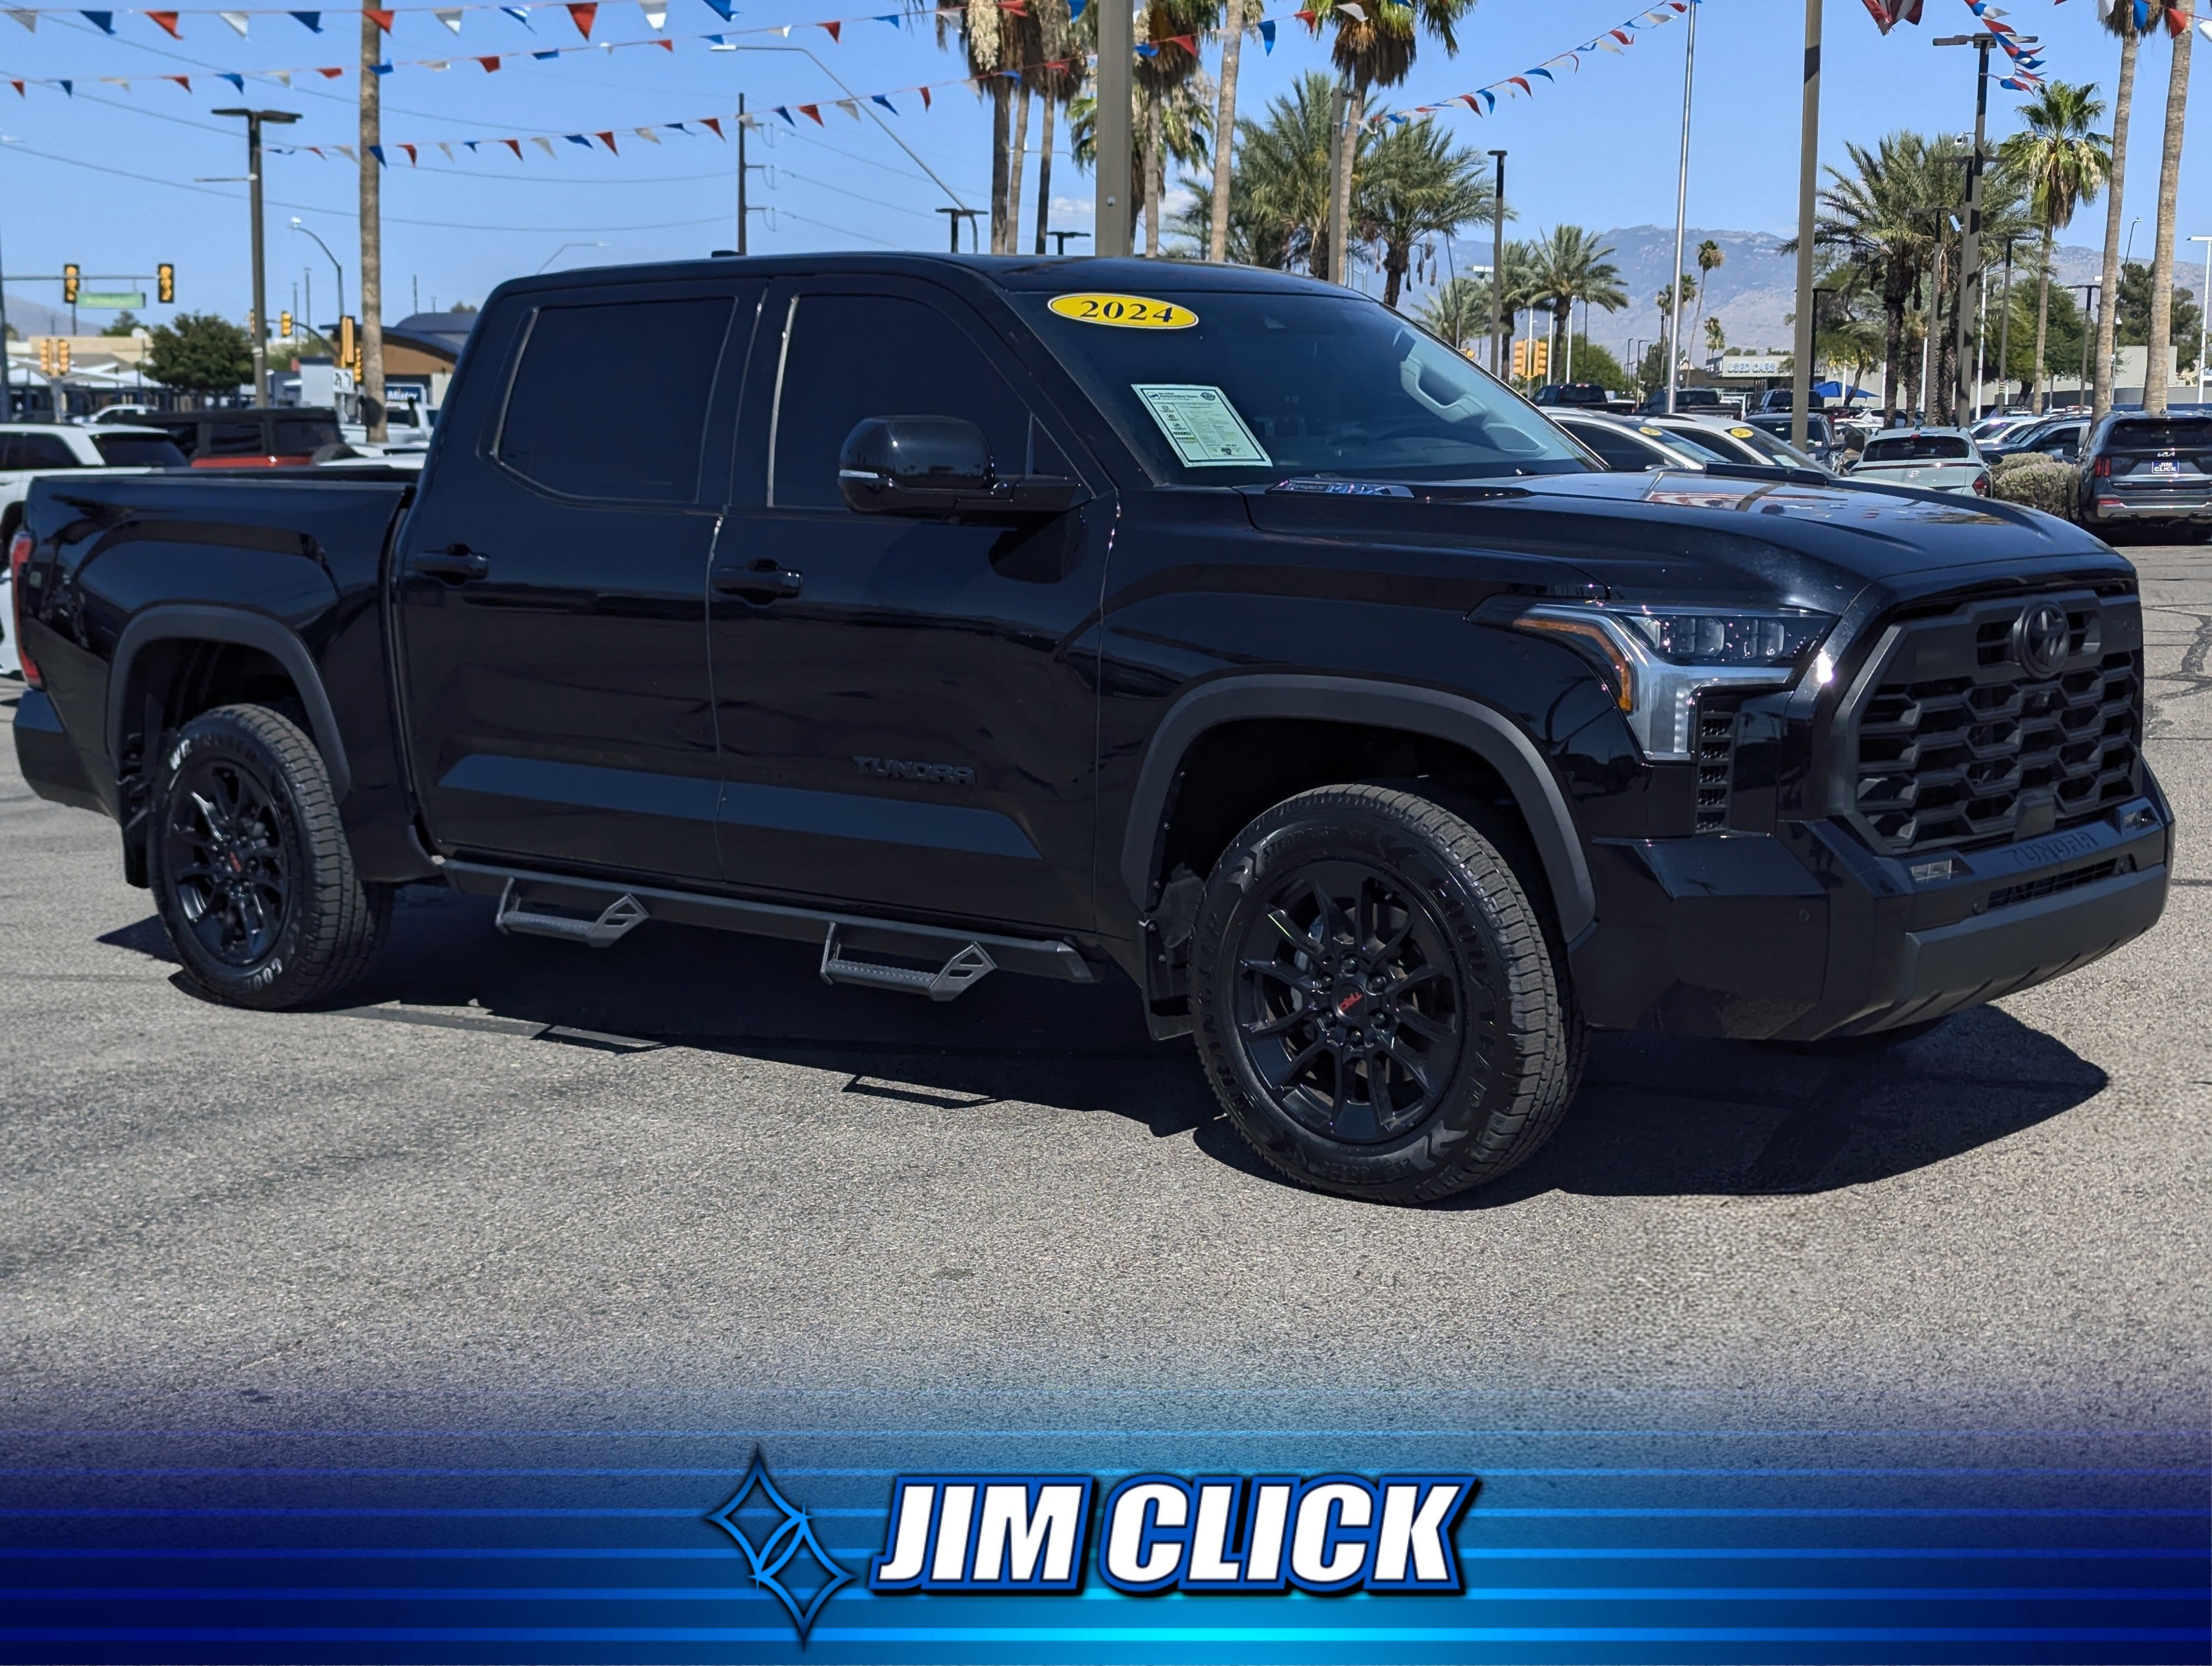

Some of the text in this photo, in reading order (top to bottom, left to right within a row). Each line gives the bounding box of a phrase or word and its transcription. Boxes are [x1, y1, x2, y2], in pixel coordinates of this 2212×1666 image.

[1079, 300, 1174, 323] 2024
[1727, 361, 1750, 373] USED
[1752, 361, 1776, 373] CARS
[852, 755, 978, 785] TUNDRA
[2001, 831, 2099, 868] TUNDRA
